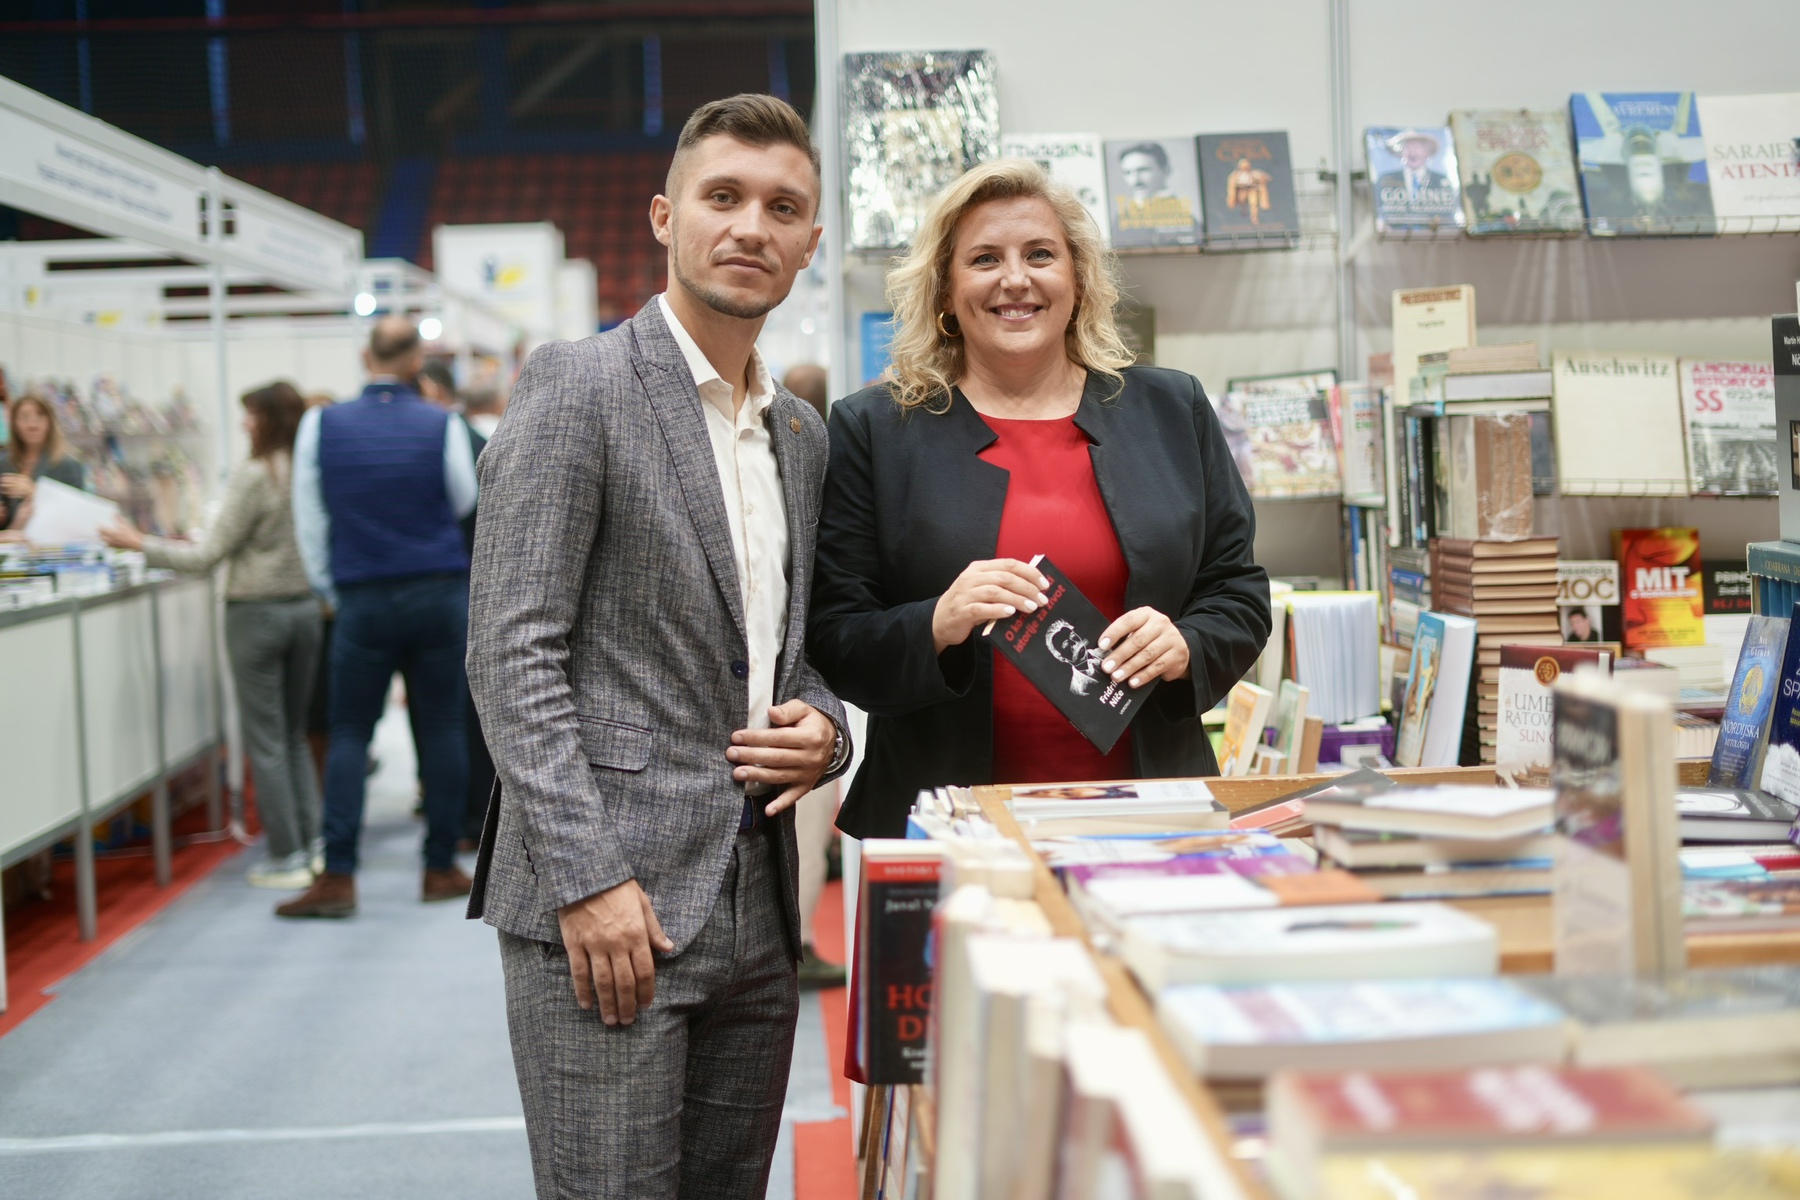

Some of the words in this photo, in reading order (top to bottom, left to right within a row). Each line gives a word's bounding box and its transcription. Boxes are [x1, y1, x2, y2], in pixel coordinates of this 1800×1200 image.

[1563, 356, 1669, 377] Auschwitz
[1694, 389, 1724, 413] SS
[1635, 567, 1690, 589] MIT
[1013, 620, 1039, 654] istorije
[1037, 609, 1048, 622] za
[1046, 584, 1066, 610] život
[1005, 630, 1015, 641] O
[1109, 689, 1124, 708] Niče
[1505, 709, 1554, 729] RATOV
[1519, 728, 1546, 743] SUN
[1721, 720, 1760, 739] NORDIJSKA
[1723, 737, 1750, 752] MITOLOGIJA
